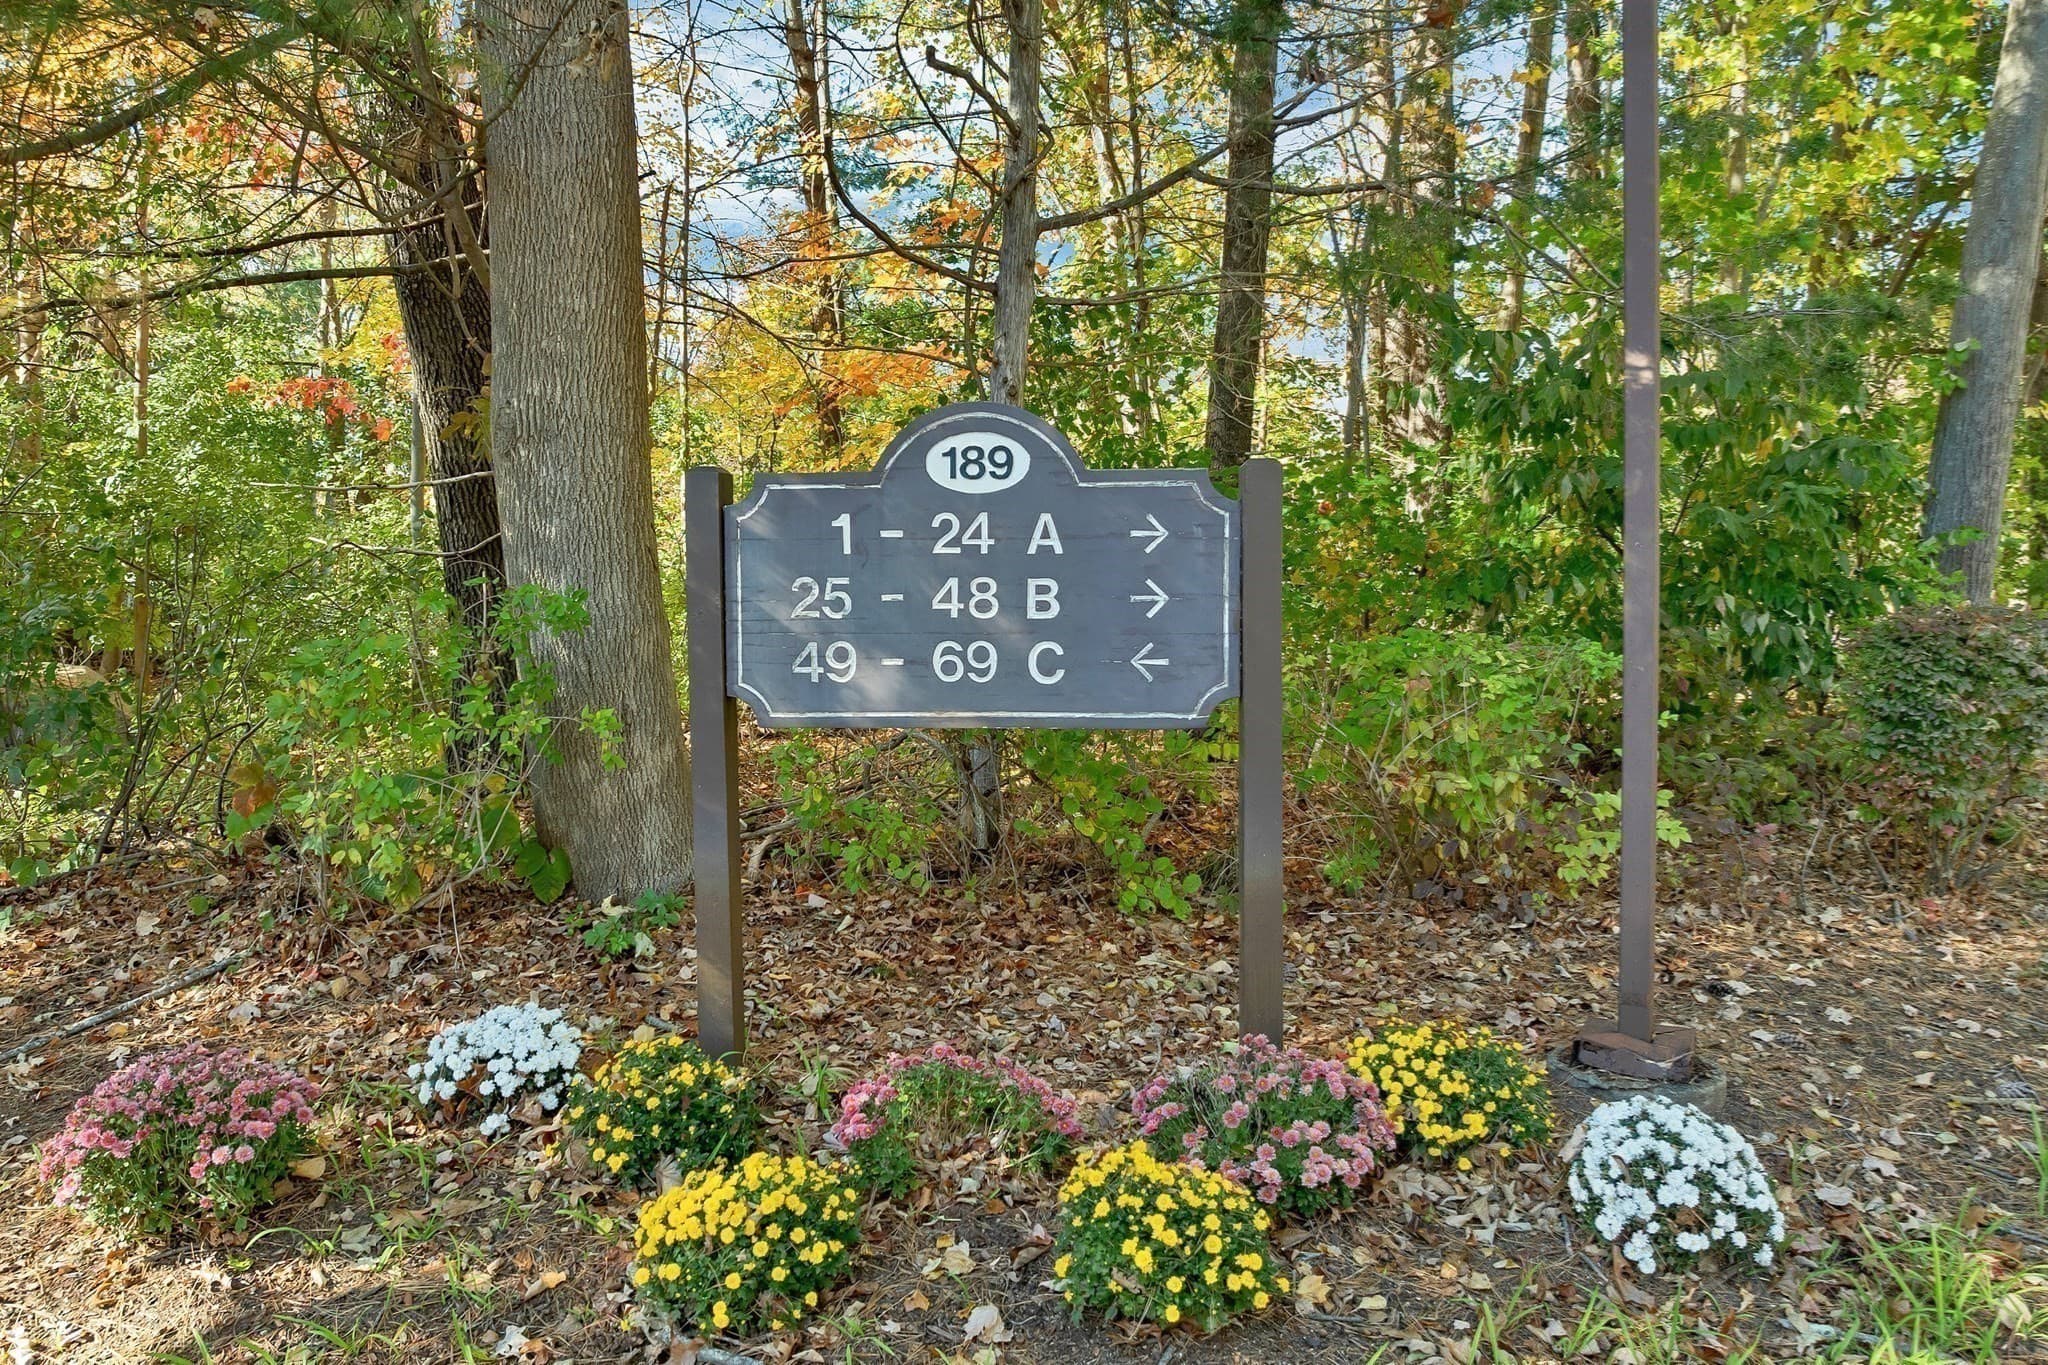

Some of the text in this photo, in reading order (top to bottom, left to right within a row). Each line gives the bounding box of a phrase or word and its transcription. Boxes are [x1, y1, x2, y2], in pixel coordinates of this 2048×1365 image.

[941, 445, 1014, 480] 189
[830, 513, 852, 555] 1
[931, 512, 995, 555] 24
[1026, 512, 1064, 555] A
[790, 576, 852, 620] 25
[931, 576, 999, 620] 48
[1026, 578, 1061, 620] B
[791, 641, 857, 683] 49
[932, 640, 998, 683] 69
[1028, 641, 1065, 685] C
